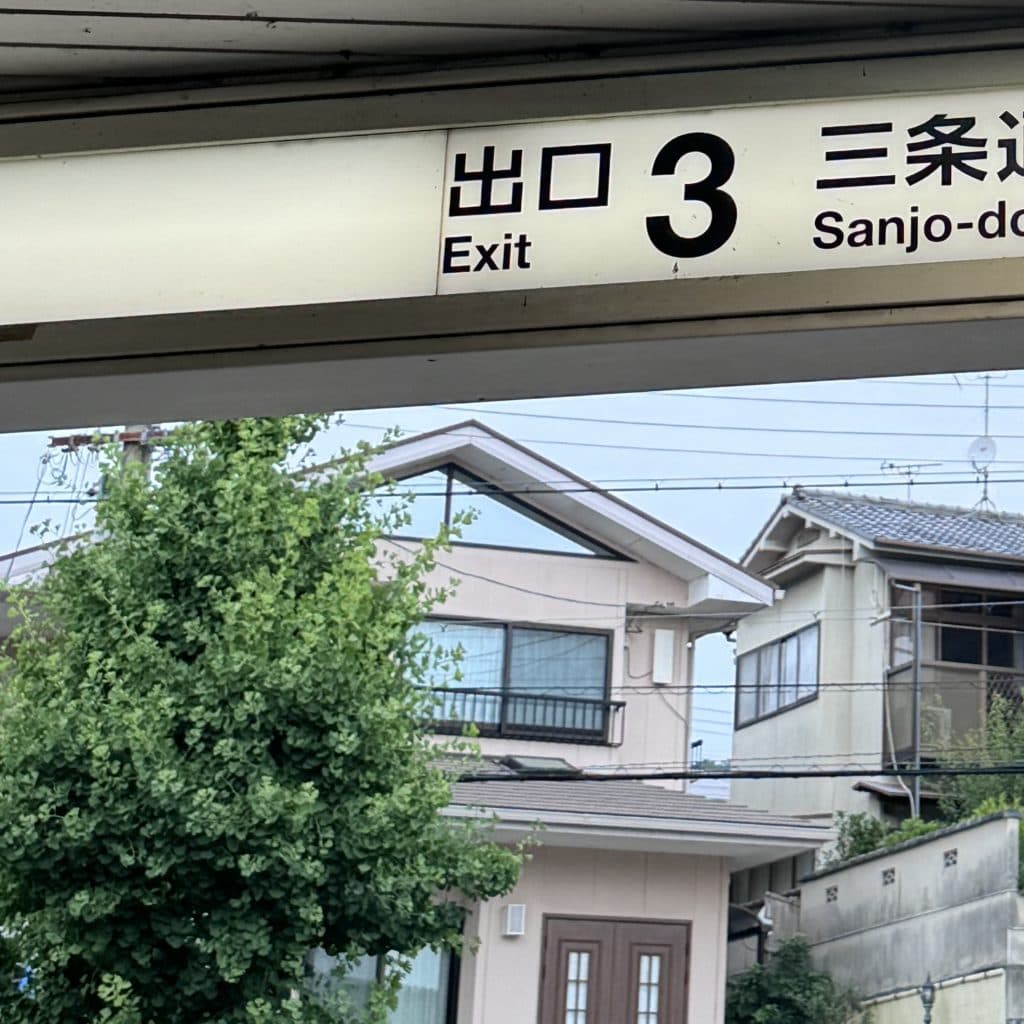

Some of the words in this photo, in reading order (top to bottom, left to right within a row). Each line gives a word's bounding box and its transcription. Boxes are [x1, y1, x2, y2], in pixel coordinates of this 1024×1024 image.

[448, 142, 612, 218] 出口
[645, 131, 738, 259] 3
[442, 233, 532, 274] Exit
